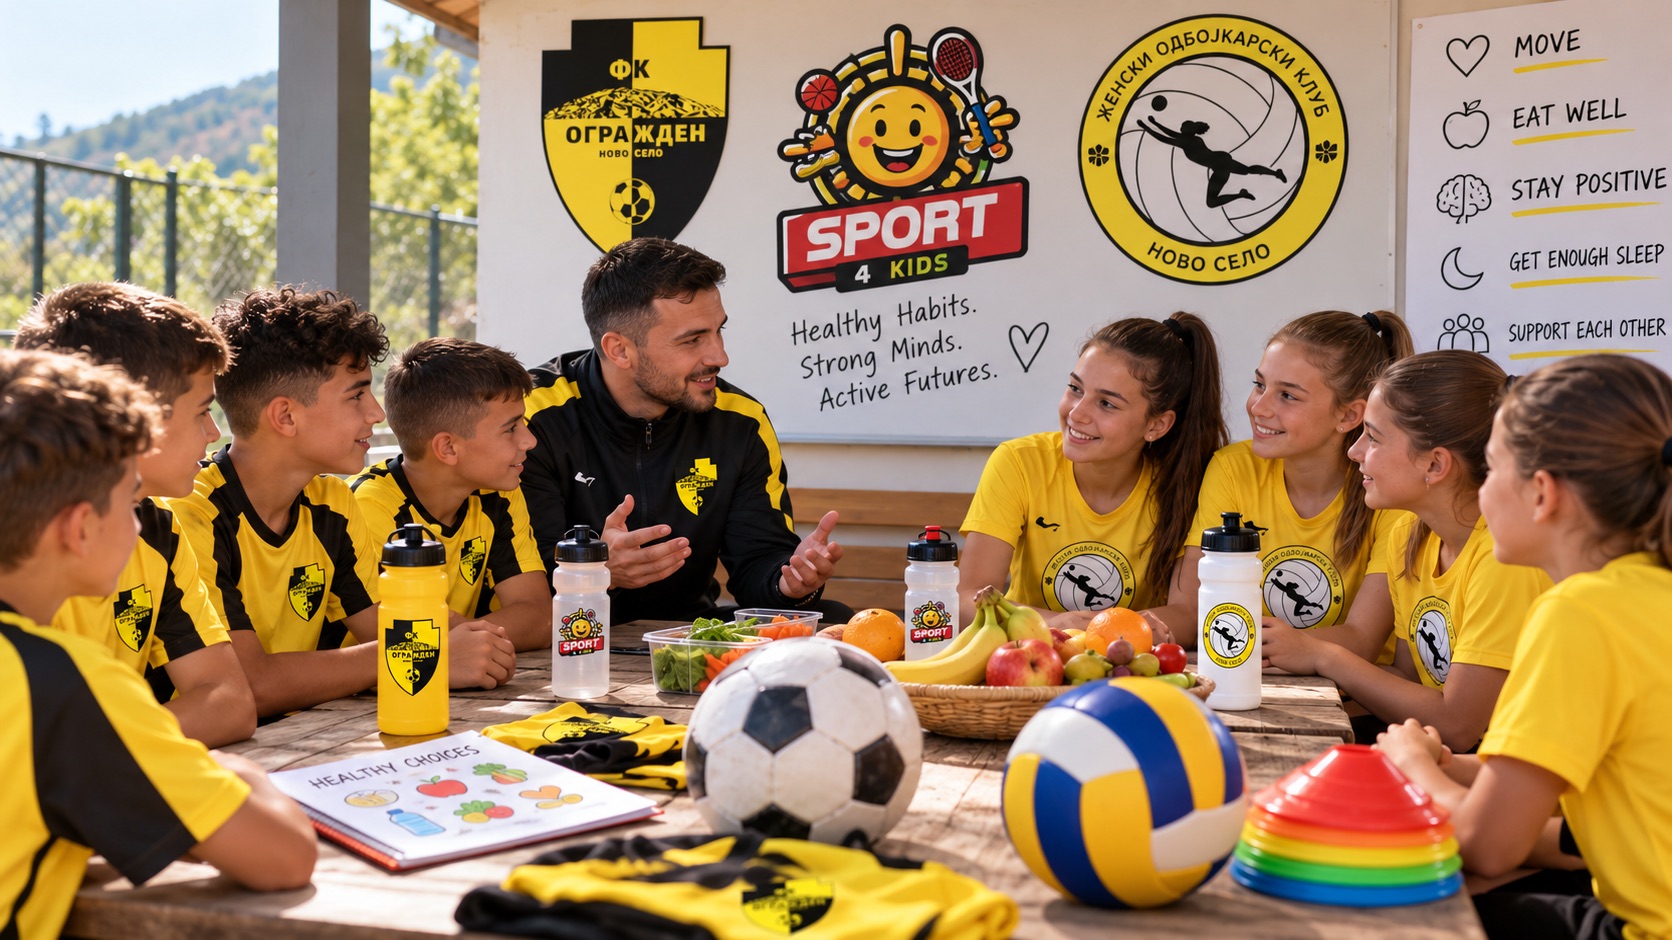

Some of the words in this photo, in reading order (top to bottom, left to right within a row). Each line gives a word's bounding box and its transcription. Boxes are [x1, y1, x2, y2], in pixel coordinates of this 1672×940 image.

[1514, 29, 1581, 58] MOVE
[609, 59, 650, 80] ФК
[1096, 52, 1153, 122] ЖЕНСКИ
[1155, 28, 1296, 70] ОДБОЈКАРСКИ
[1293, 67, 1330, 118] КЛУБ
[1513, 104, 1556, 129] EAT
[1566, 98, 1627, 123] WELL
[566, 124, 706, 146] ОГРАЖДЕН
[599, 150, 629, 158] НОВО
[634, 149, 663, 158] СЕЛО
[1511, 174, 1564, 201] STAY
[1576, 167, 1667, 196] POSITIVE
[807, 192, 998, 262] SPORT
[854, 264, 871, 284] 4
[890, 253, 948, 279] KIDS
[1147, 242, 1206, 272] НОВО
[1214, 243, 1270, 272] СЕЛО
[1509, 251, 1541, 272] GET
[1548, 247, 1608, 270] ENOUGH
[1616, 243, 1664, 266] SLEEP
[791, 309, 882, 346] Healthy
[897, 293, 977, 326] Habits.
[1509, 321, 1570, 342] SUPPORT
[1576, 319, 1613, 339] EACH
[1619, 317, 1666, 338] OTHER
[800, 350, 877, 379] Strong
[891, 329, 962, 362] Minds.
[820, 382, 891, 411] Active
[904, 362, 998, 395] Futures.
[563, 638, 600, 651] SPORT
[914, 627, 949, 638] SPORT
[308, 762, 398, 789] HEALTHY
[404, 745, 480, 768] CHOICES
